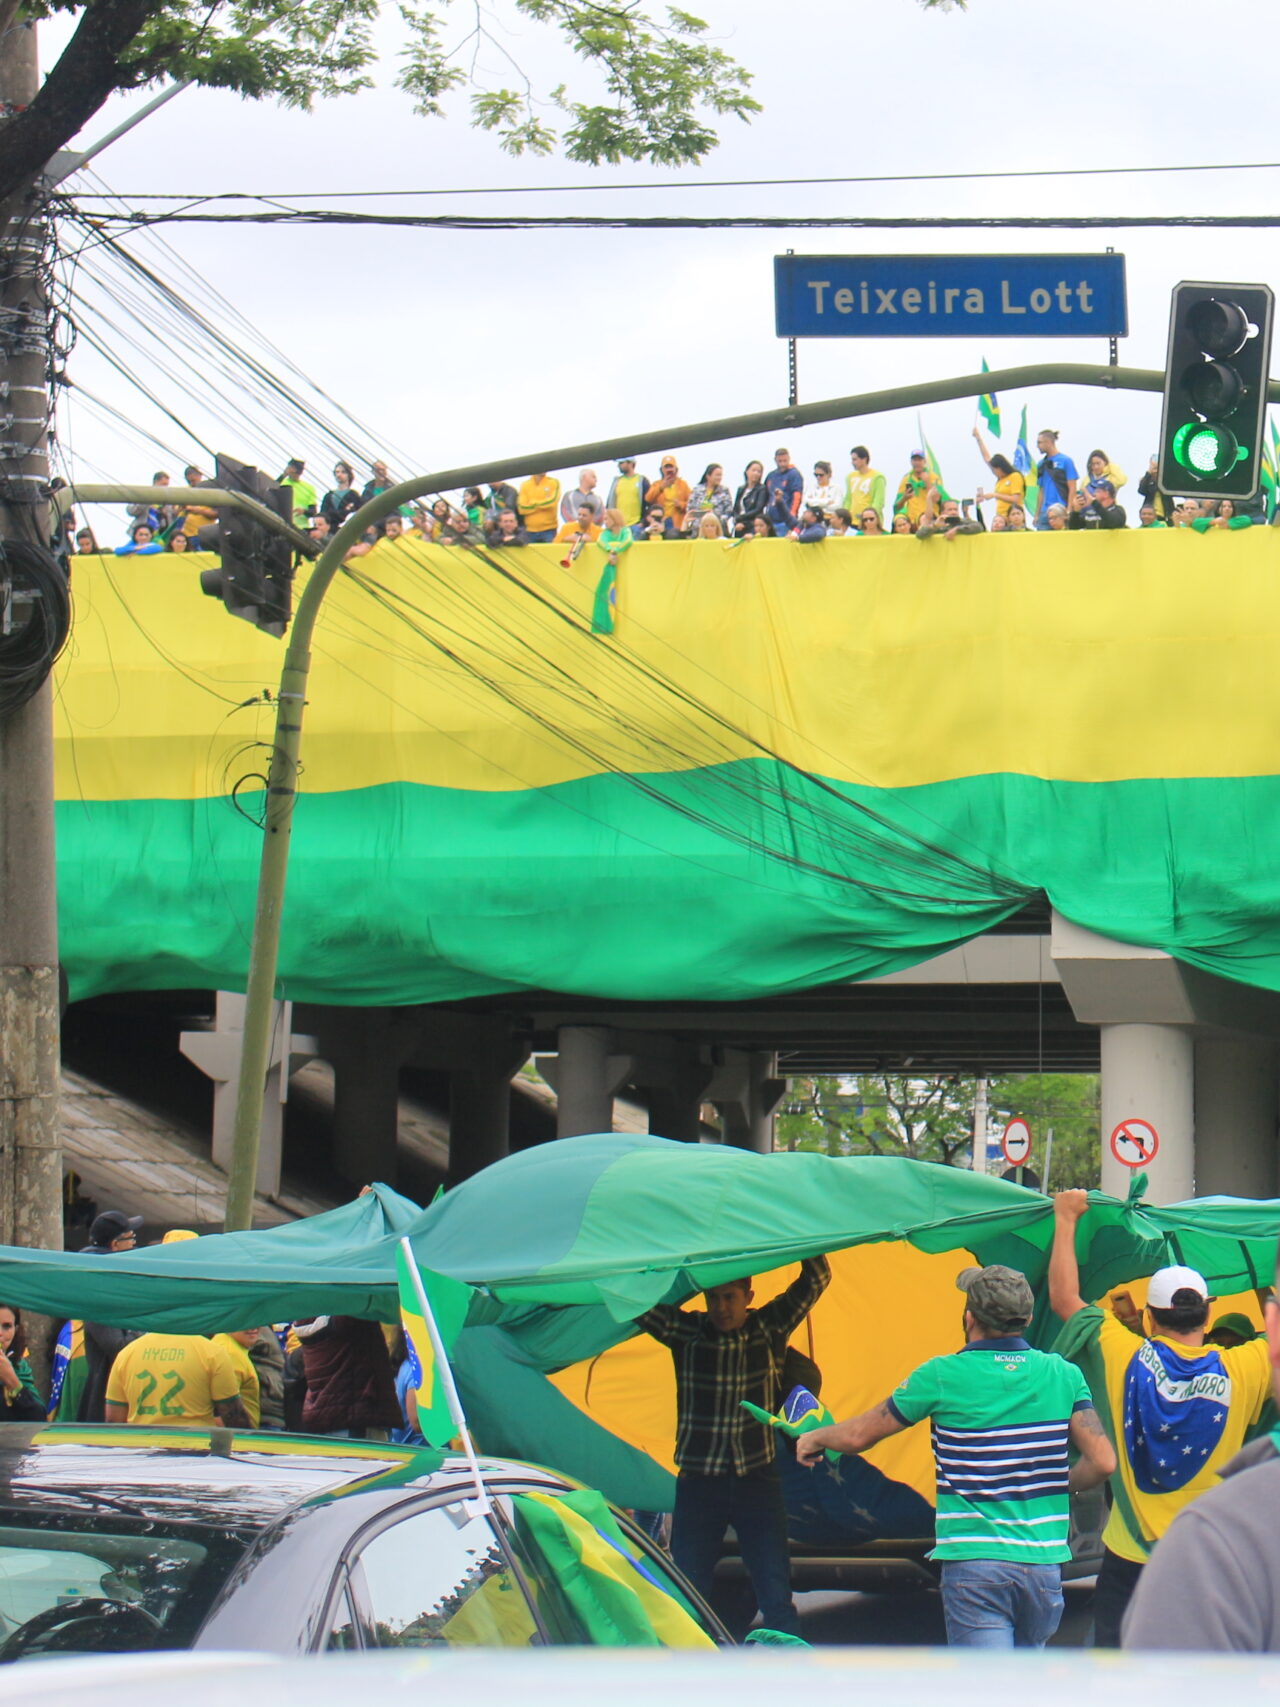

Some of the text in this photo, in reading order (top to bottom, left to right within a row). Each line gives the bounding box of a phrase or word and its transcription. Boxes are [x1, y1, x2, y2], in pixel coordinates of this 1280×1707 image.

[807, 280, 1094, 315] Teixeira Lott
[142, 1348, 186, 1361] HYGOR
[135, 1369, 186, 1416] 22
